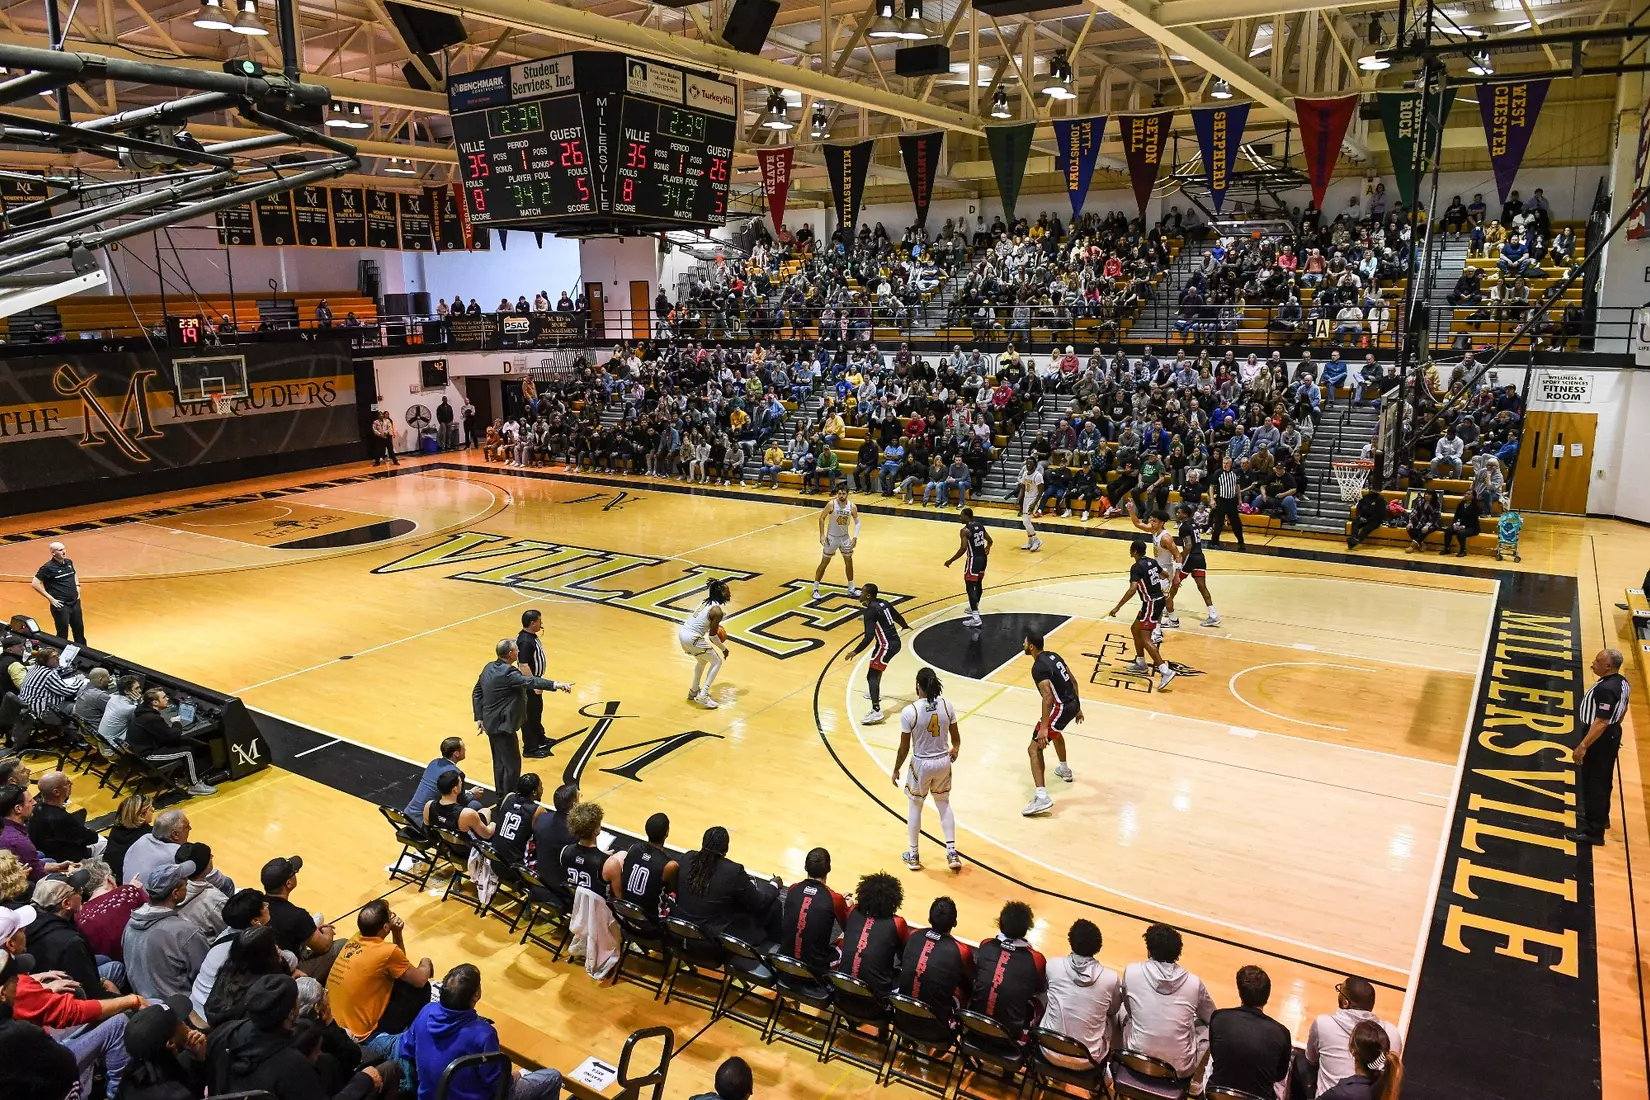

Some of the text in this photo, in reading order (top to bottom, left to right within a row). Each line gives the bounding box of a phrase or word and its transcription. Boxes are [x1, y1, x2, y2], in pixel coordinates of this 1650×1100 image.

[524, 61, 559, 79] Student
[459, 77, 503, 92] BENCHMARK
[512, 75, 573, 95] Services, Inc.
[1511, 84, 1527, 128] WEST
[501, 105, 541, 133] 2:39
[1399, 100, 1413, 139] ROCK
[1492, 86, 1509, 157] CHESTER
[550, 127, 582, 141] GUEST
[625, 127, 651, 143] VILLE
[1081, 121, 1092, 156] PITT-
[1131, 118, 1144, 153] HILL
[1145, 117, 1159, 164] SETON
[460, 140, 486, 154] VILLE
[507, 140, 529, 150] PERIOD
[533, 147, 548, 156] POSS
[670, 142, 690, 153] PERIOD
[706, 145, 732, 158] GUEST
[1213, 111, 1227, 190] SHEPHERD
[493, 152, 508, 161] POSS
[521, 149, 528, 170] 1
[560, 141, 584, 167] 26
[596, 97, 610, 211] MILLERSVILLE
[626, 143, 647, 169] 35
[654, 149, 668, 159] POSS
[690, 155, 703, 165] POSS
[1069, 123, 1080, 191] JOHNSTOWN
[468, 154, 490, 178] 35
[495, 165, 513, 174] BONUS
[532, 160, 550, 169] BONUS
[567, 167, 588, 176] FOULS
[653, 162, 670, 172] BONUS
[679, 153, 684, 174] 1
[709, 158, 728, 181] 26
[776, 153, 785, 183] LOCK
[508, 171, 551, 183] PLAYER FOUL
[619, 167, 638, 178] FOULS
[686, 167, 701, 177] BONUS
[766, 155, 776, 195] HAVEN
[917, 139, 927, 208] MANSFIELD
[465, 180, 484, 188] FOULS
[662, 174, 699, 187] PLAYER FOUL
[711, 182, 728, 192] FOULS
[577, 177, 590, 201] 5
[623, 178, 634, 202] 8
[843, 149, 852, 229] MILLERSVILLE
[1366, 185, 1374, 195] A
[473, 188, 485, 211] 8
[432, 191, 441, 241] BLOOMSBURG
[520, 208, 542, 217] MATCH
[567, 203, 590, 213] SCORE
[615, 203, 636, 213] SCORE
[674, 210, 692, 219] MATCH
[969, 205, 976, 214] D
[471, 212, 491, 221] SCORE
[708, 214, 725, 223] SCORE
[179, 318, 199, 328] 2:39
[505, 321, 529, 329] PSAC
[733, 319, 741, 333] D
[1317, 320, 1327, 337] A
[182, 328, 198, 344] 19
[434, 361, 444, 371] 42
[503, 361, 511, 373] D
[1543, 385, 1586, 393] FITNESS
[1546, 392, 1581, 401] ROOM
[0, 407, 67, 438] THE
[371, 530, 917, 661] VILLE
[883, 608, 894, 626] 11
[1055, 661, 1069, 683] 2
[927, 713, 941, 738] 4
[1442, 610, 1579, 979] MILLERSVILLE
[499, 811, 522, 841] 12
[626, 863, 650, 896] 10
